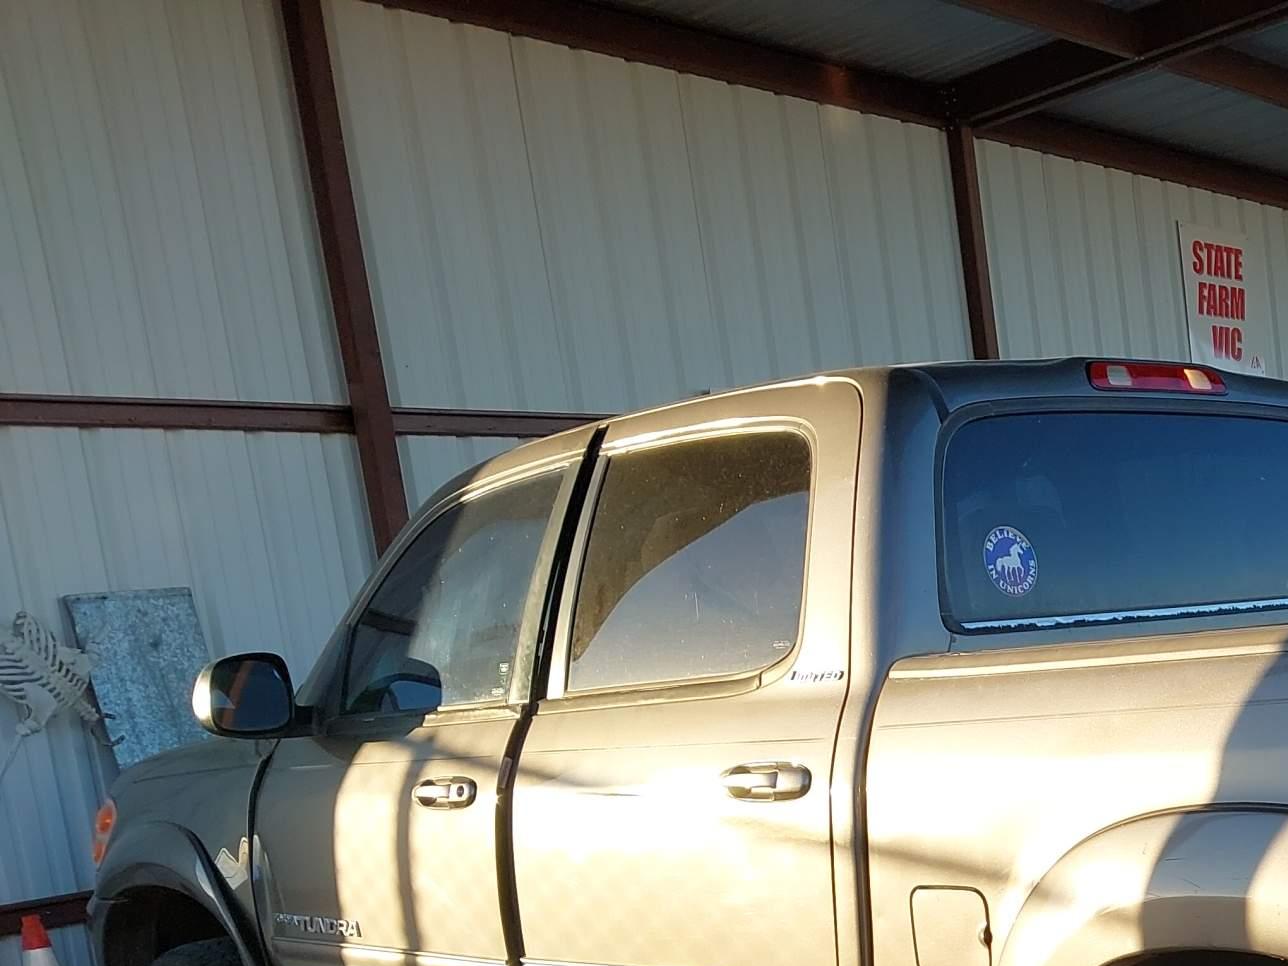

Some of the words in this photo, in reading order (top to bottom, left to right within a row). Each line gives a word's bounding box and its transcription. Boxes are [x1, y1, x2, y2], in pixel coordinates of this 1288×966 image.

[1191, 240, 1243, 281] STATE
[1198, 282, 1246, 321] FARM
[1211, 325, 1243, 361] VIC
[986, 529, 1030, 552] BELIEVE
[987, 564, 999, 580] IN
[999, 559, 1037, 594] UNICORNS
[299, 915, 363, 938] TUNDRA
